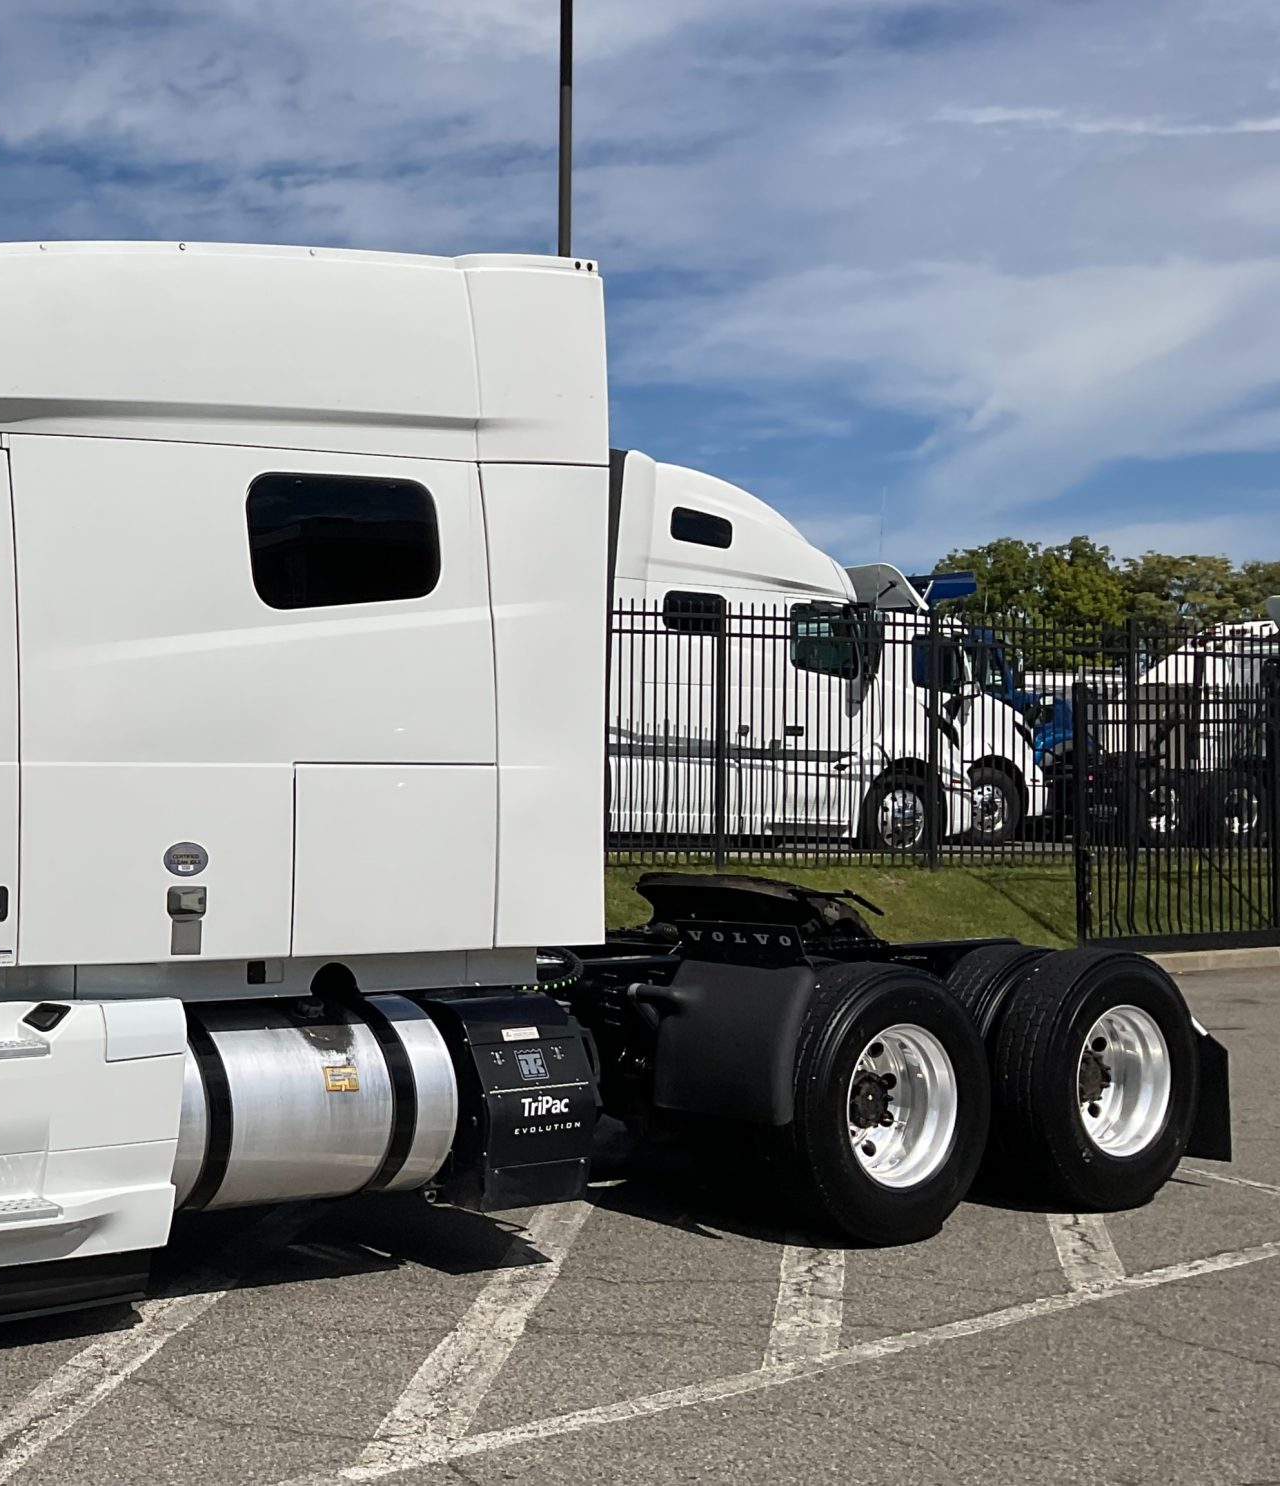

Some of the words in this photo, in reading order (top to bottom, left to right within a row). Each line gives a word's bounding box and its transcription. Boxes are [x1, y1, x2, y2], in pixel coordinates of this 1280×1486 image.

[687, 930, 792, 947] VOLVO
[521, 1096, 570, 1117] TriPac
[514, 1121, 581, 1135] EVOLUTION
